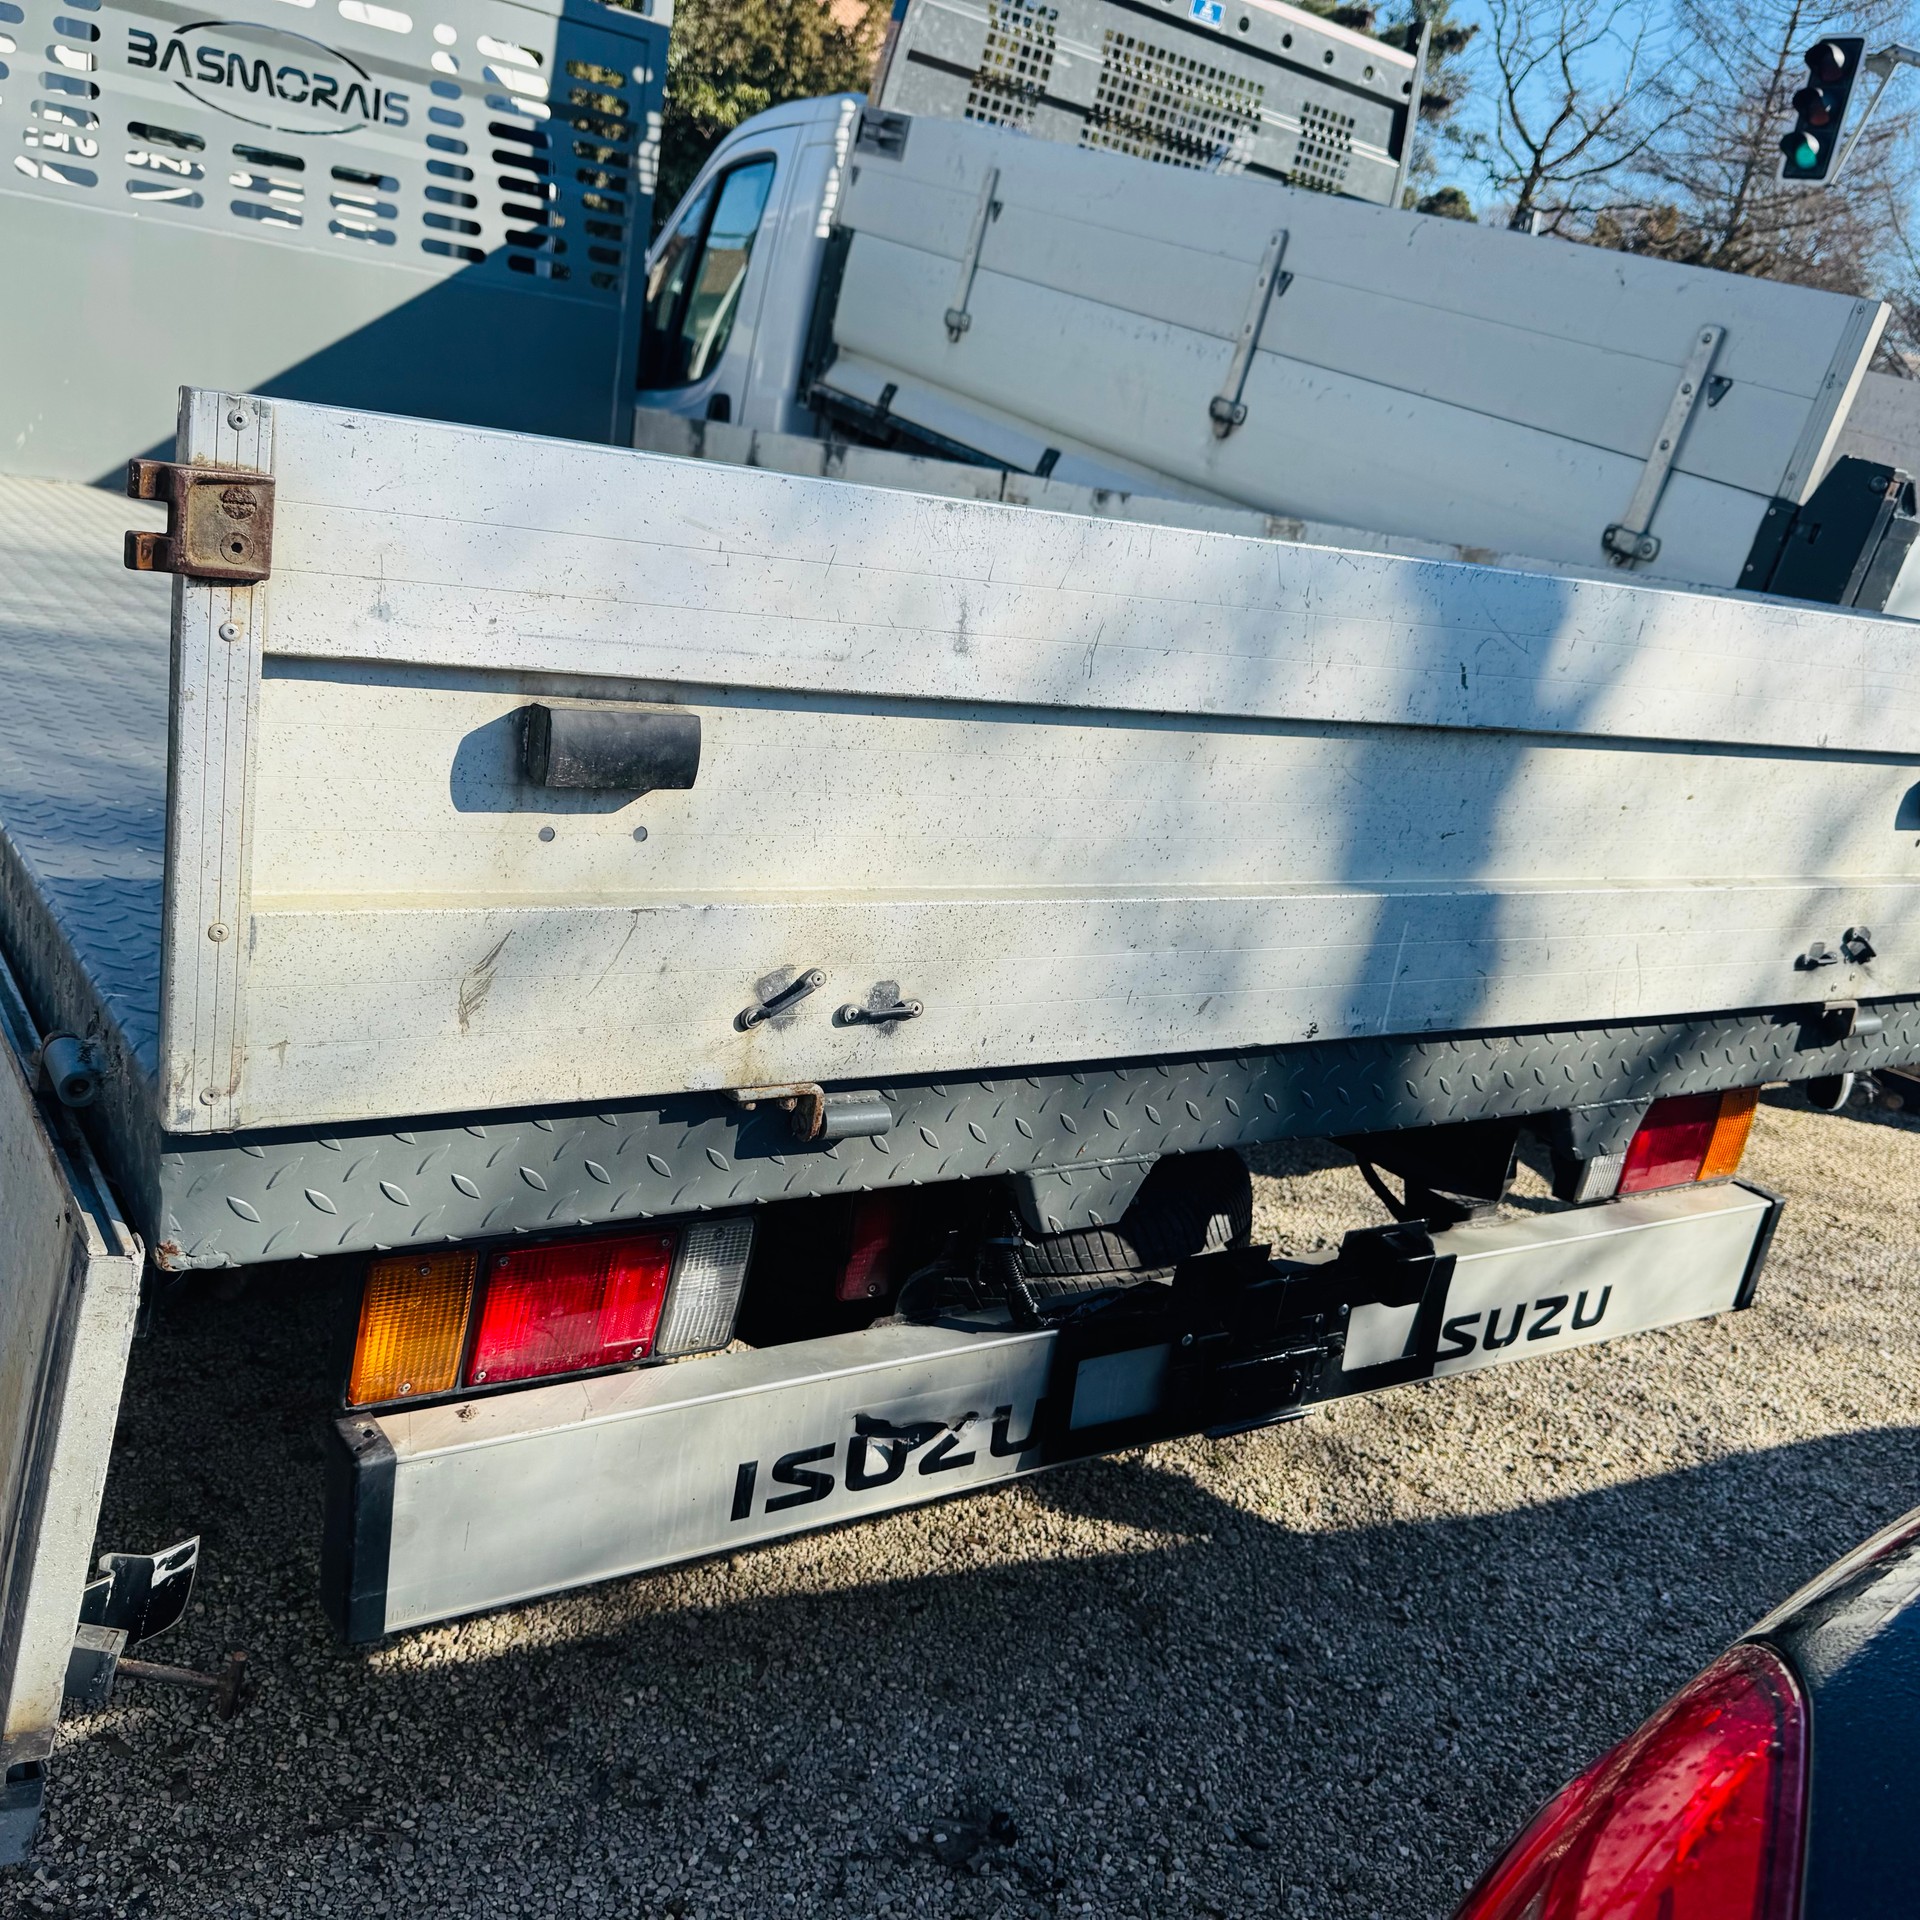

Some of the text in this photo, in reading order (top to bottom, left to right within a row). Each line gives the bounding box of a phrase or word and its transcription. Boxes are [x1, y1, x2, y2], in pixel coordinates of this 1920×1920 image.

[127, 27, 410, 128] BASMORAIS
[1435, 1284, 1613, 1363] SUZU
[730, 1397, 1048, 1522] ISUZU
